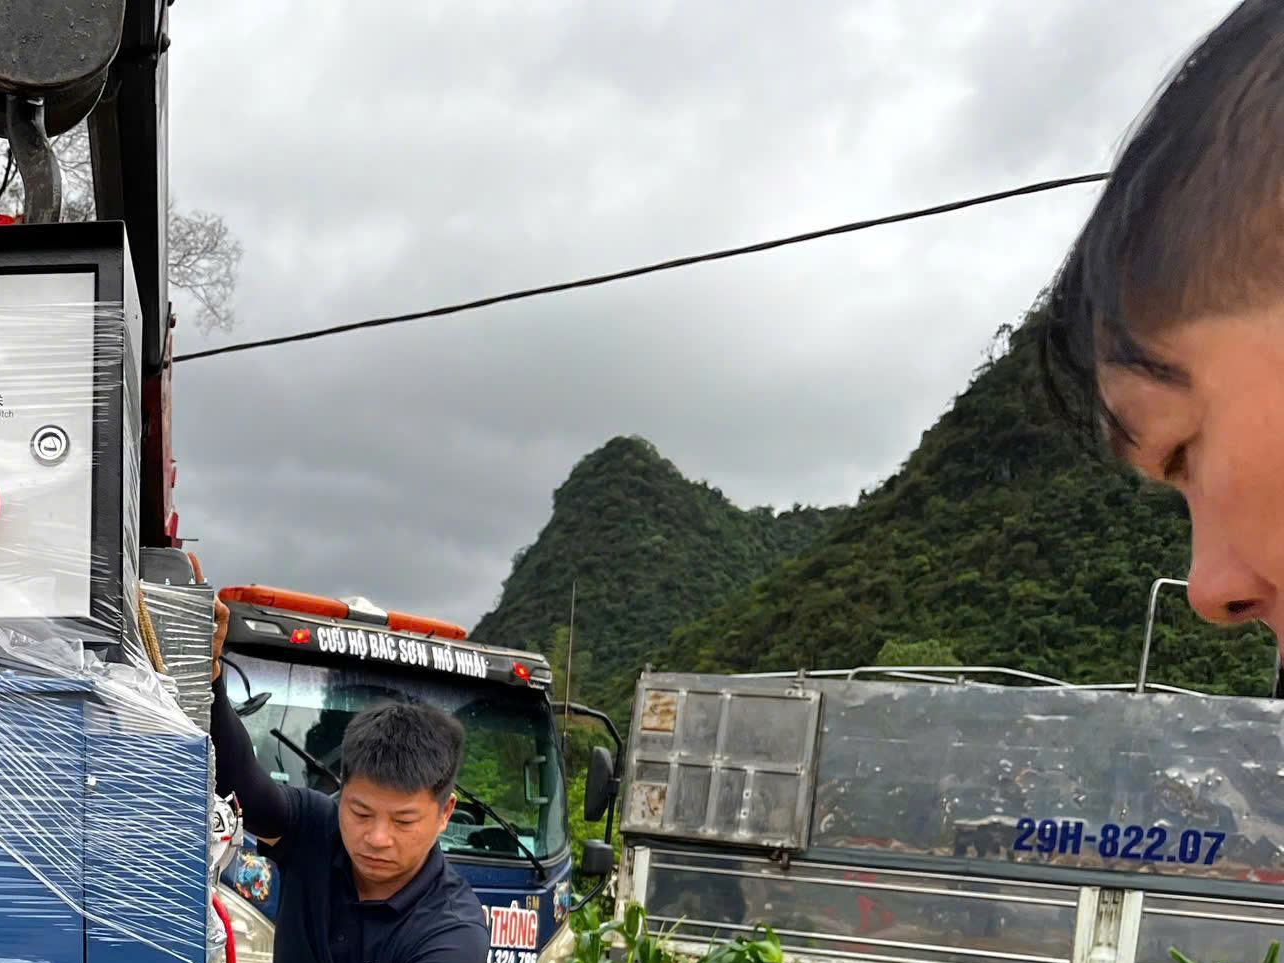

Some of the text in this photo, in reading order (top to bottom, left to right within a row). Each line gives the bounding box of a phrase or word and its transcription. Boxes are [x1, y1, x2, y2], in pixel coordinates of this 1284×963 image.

[399, 639, 428, 667] SƠN
[1013, 817, 1226, 865] 29H-822.07
[491, 900, 537, 949] THÔNG
